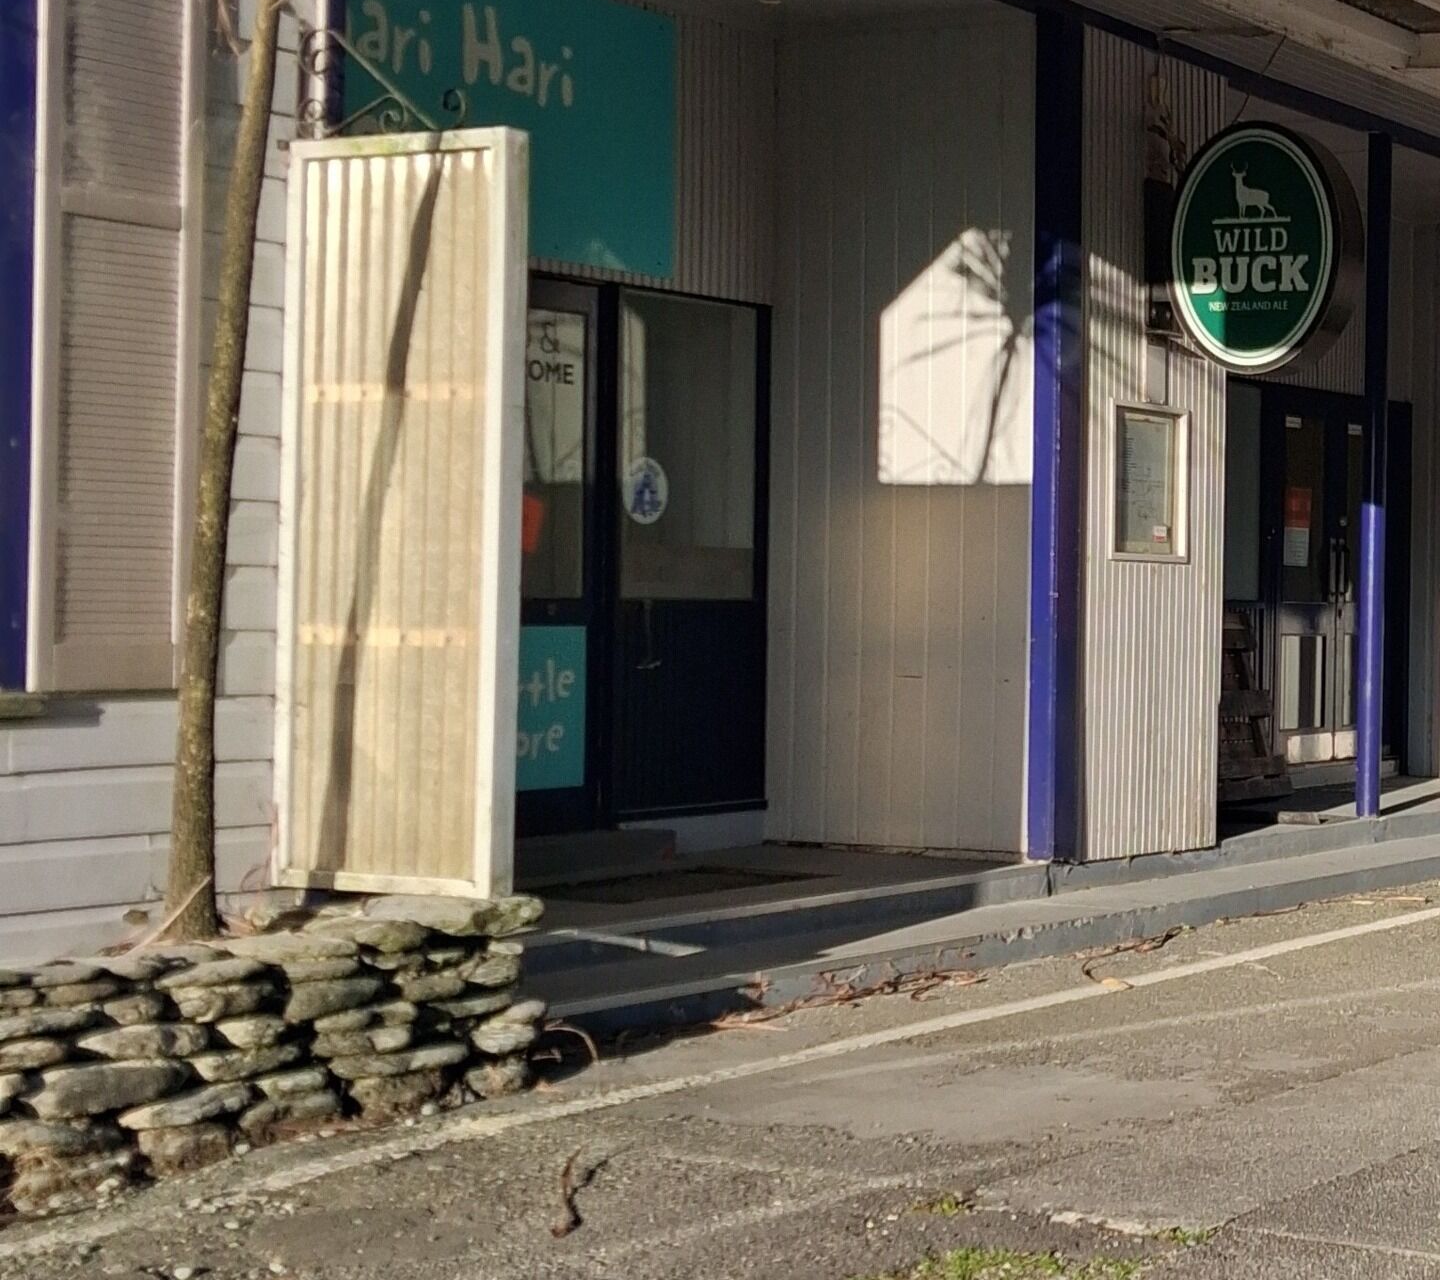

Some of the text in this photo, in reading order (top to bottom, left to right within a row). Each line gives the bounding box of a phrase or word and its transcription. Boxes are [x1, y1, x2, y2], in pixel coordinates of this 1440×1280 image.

[345, 0, 574, 108] ari Hari
[1214, 227, 1288, 252] WILD
[1191, 255, 1309, 294] BUCK
[1208, 300, 1288, 312] NEW ZEALAND ALE
[528, 360, 575, 385] OME
[519, 658, 576, 708] tle
[517, 724, 565, 760] ore
